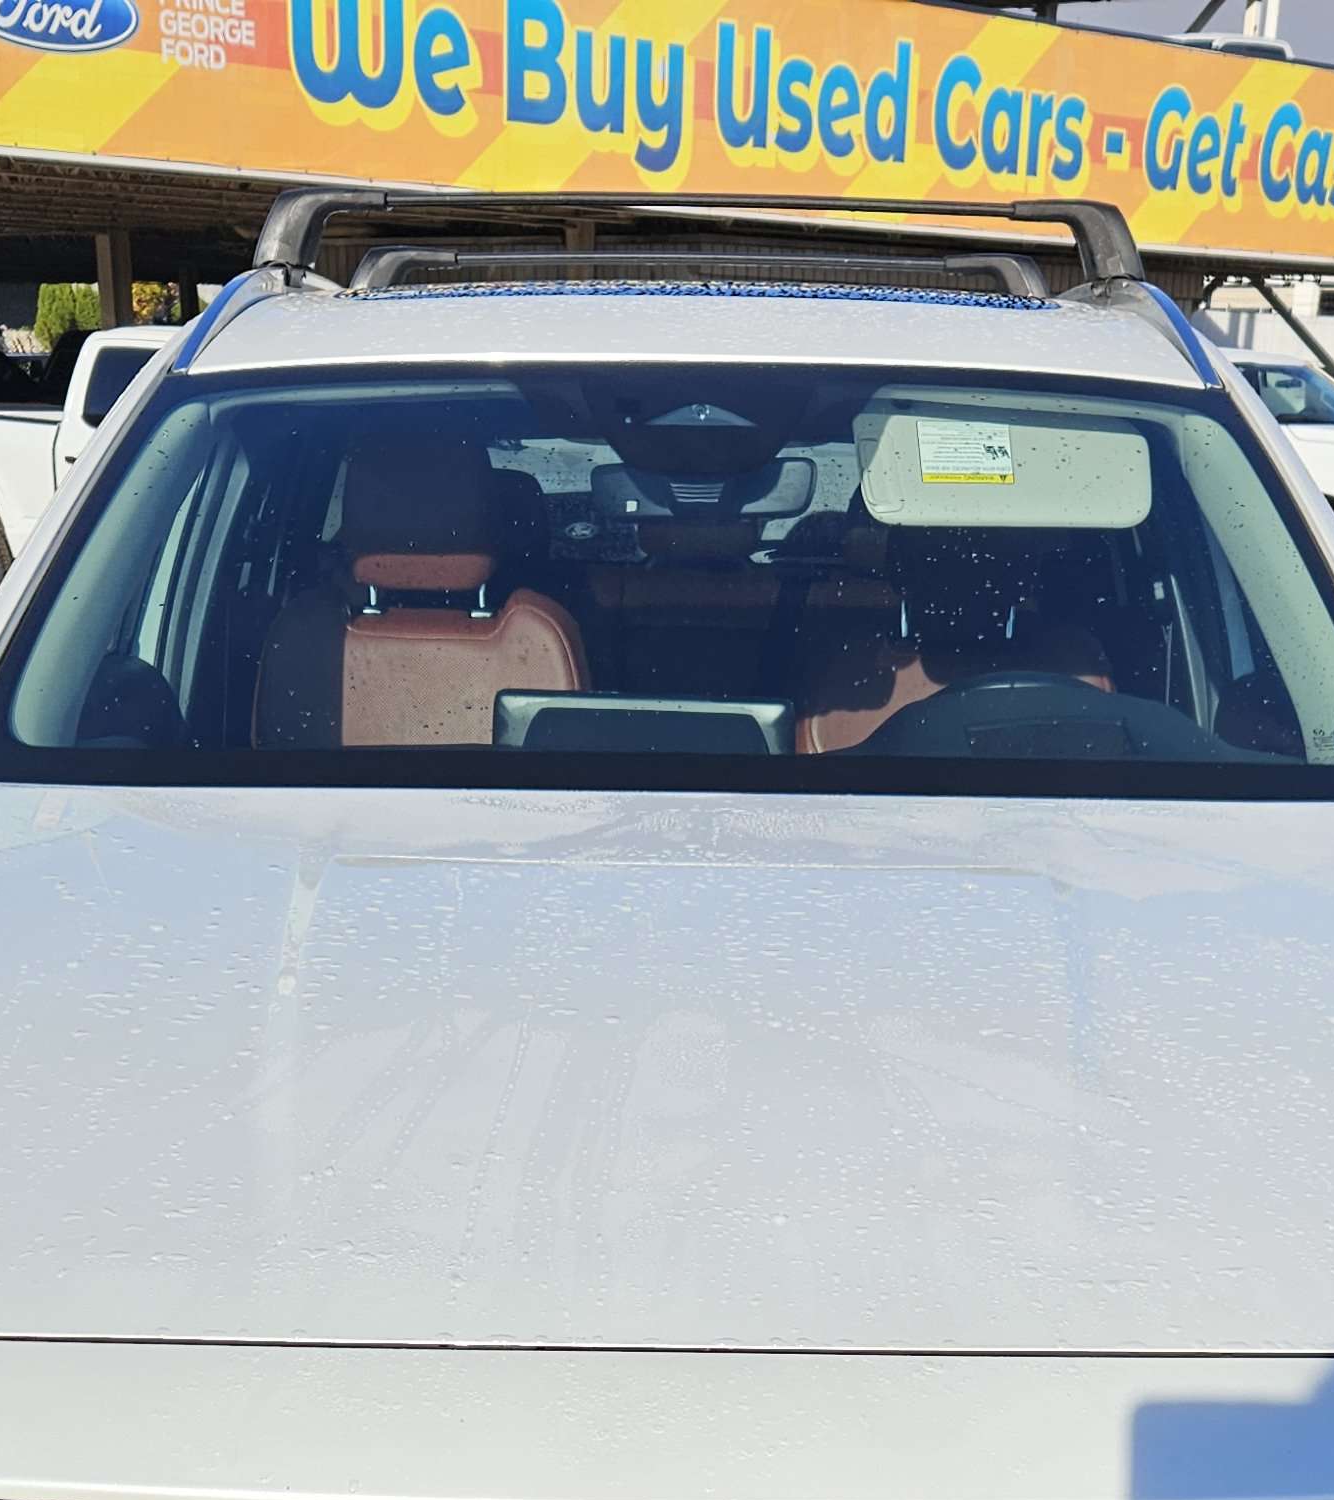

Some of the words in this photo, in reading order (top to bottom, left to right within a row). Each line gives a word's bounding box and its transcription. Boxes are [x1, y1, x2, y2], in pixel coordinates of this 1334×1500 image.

[160, 9, 256, 47] GEORGE
[161, 37, 226, 70] FORD
[290, 0, 471, 117] We
[505, 0, 686, 173] Buy
[716, 20, 914, 163] Used
[933, 54, 1087, 182] Cars
[1144, 85, 1247, 198] Get
